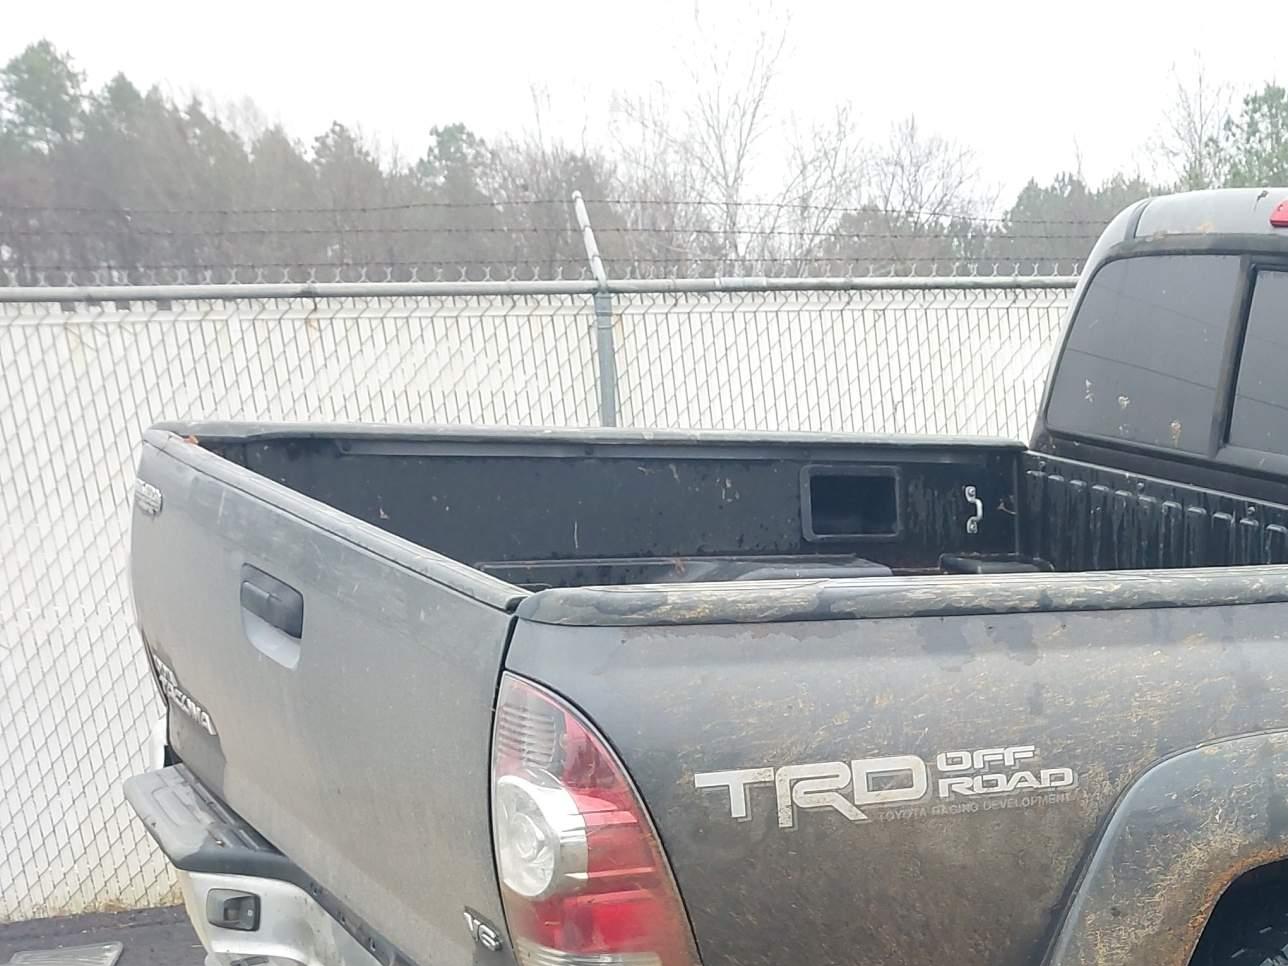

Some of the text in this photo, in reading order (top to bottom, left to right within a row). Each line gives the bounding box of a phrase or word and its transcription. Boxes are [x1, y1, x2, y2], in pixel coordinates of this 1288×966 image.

[936, 745, 1037, 772] OFF
[694, 754, 930, 829] TRD
[937, 767, 1075, 798] ROAD
[879, 805, 928, 823] TOYOTA
[463, 911, 502, 952] V6
